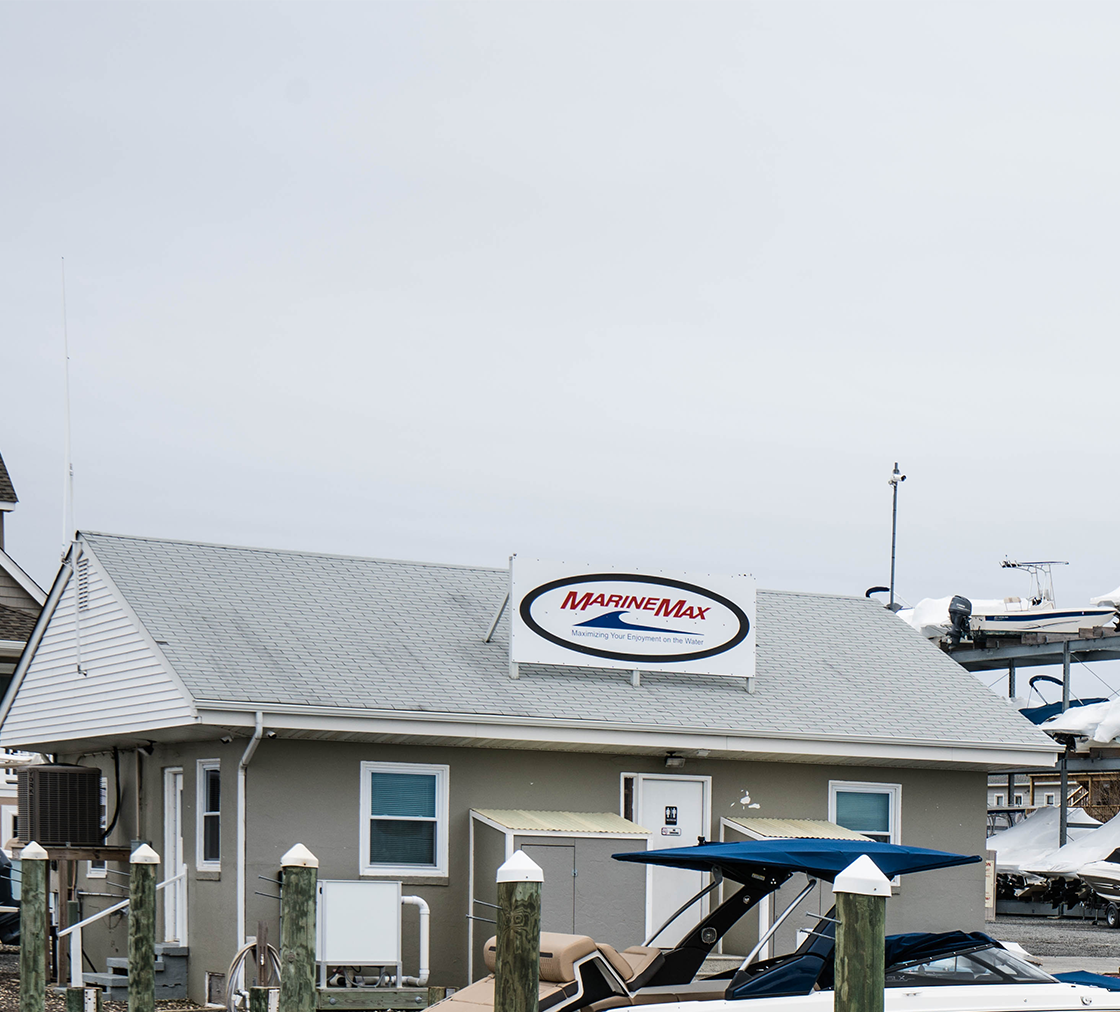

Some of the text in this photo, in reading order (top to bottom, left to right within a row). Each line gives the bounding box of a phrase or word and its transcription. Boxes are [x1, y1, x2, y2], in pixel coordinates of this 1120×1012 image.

[571, 629, 609, 640] Maximizing
[610, 632, 625, 640] Your
[627, 633, 661, 643] Enjoyment
[673, 636, 683, 644] the
